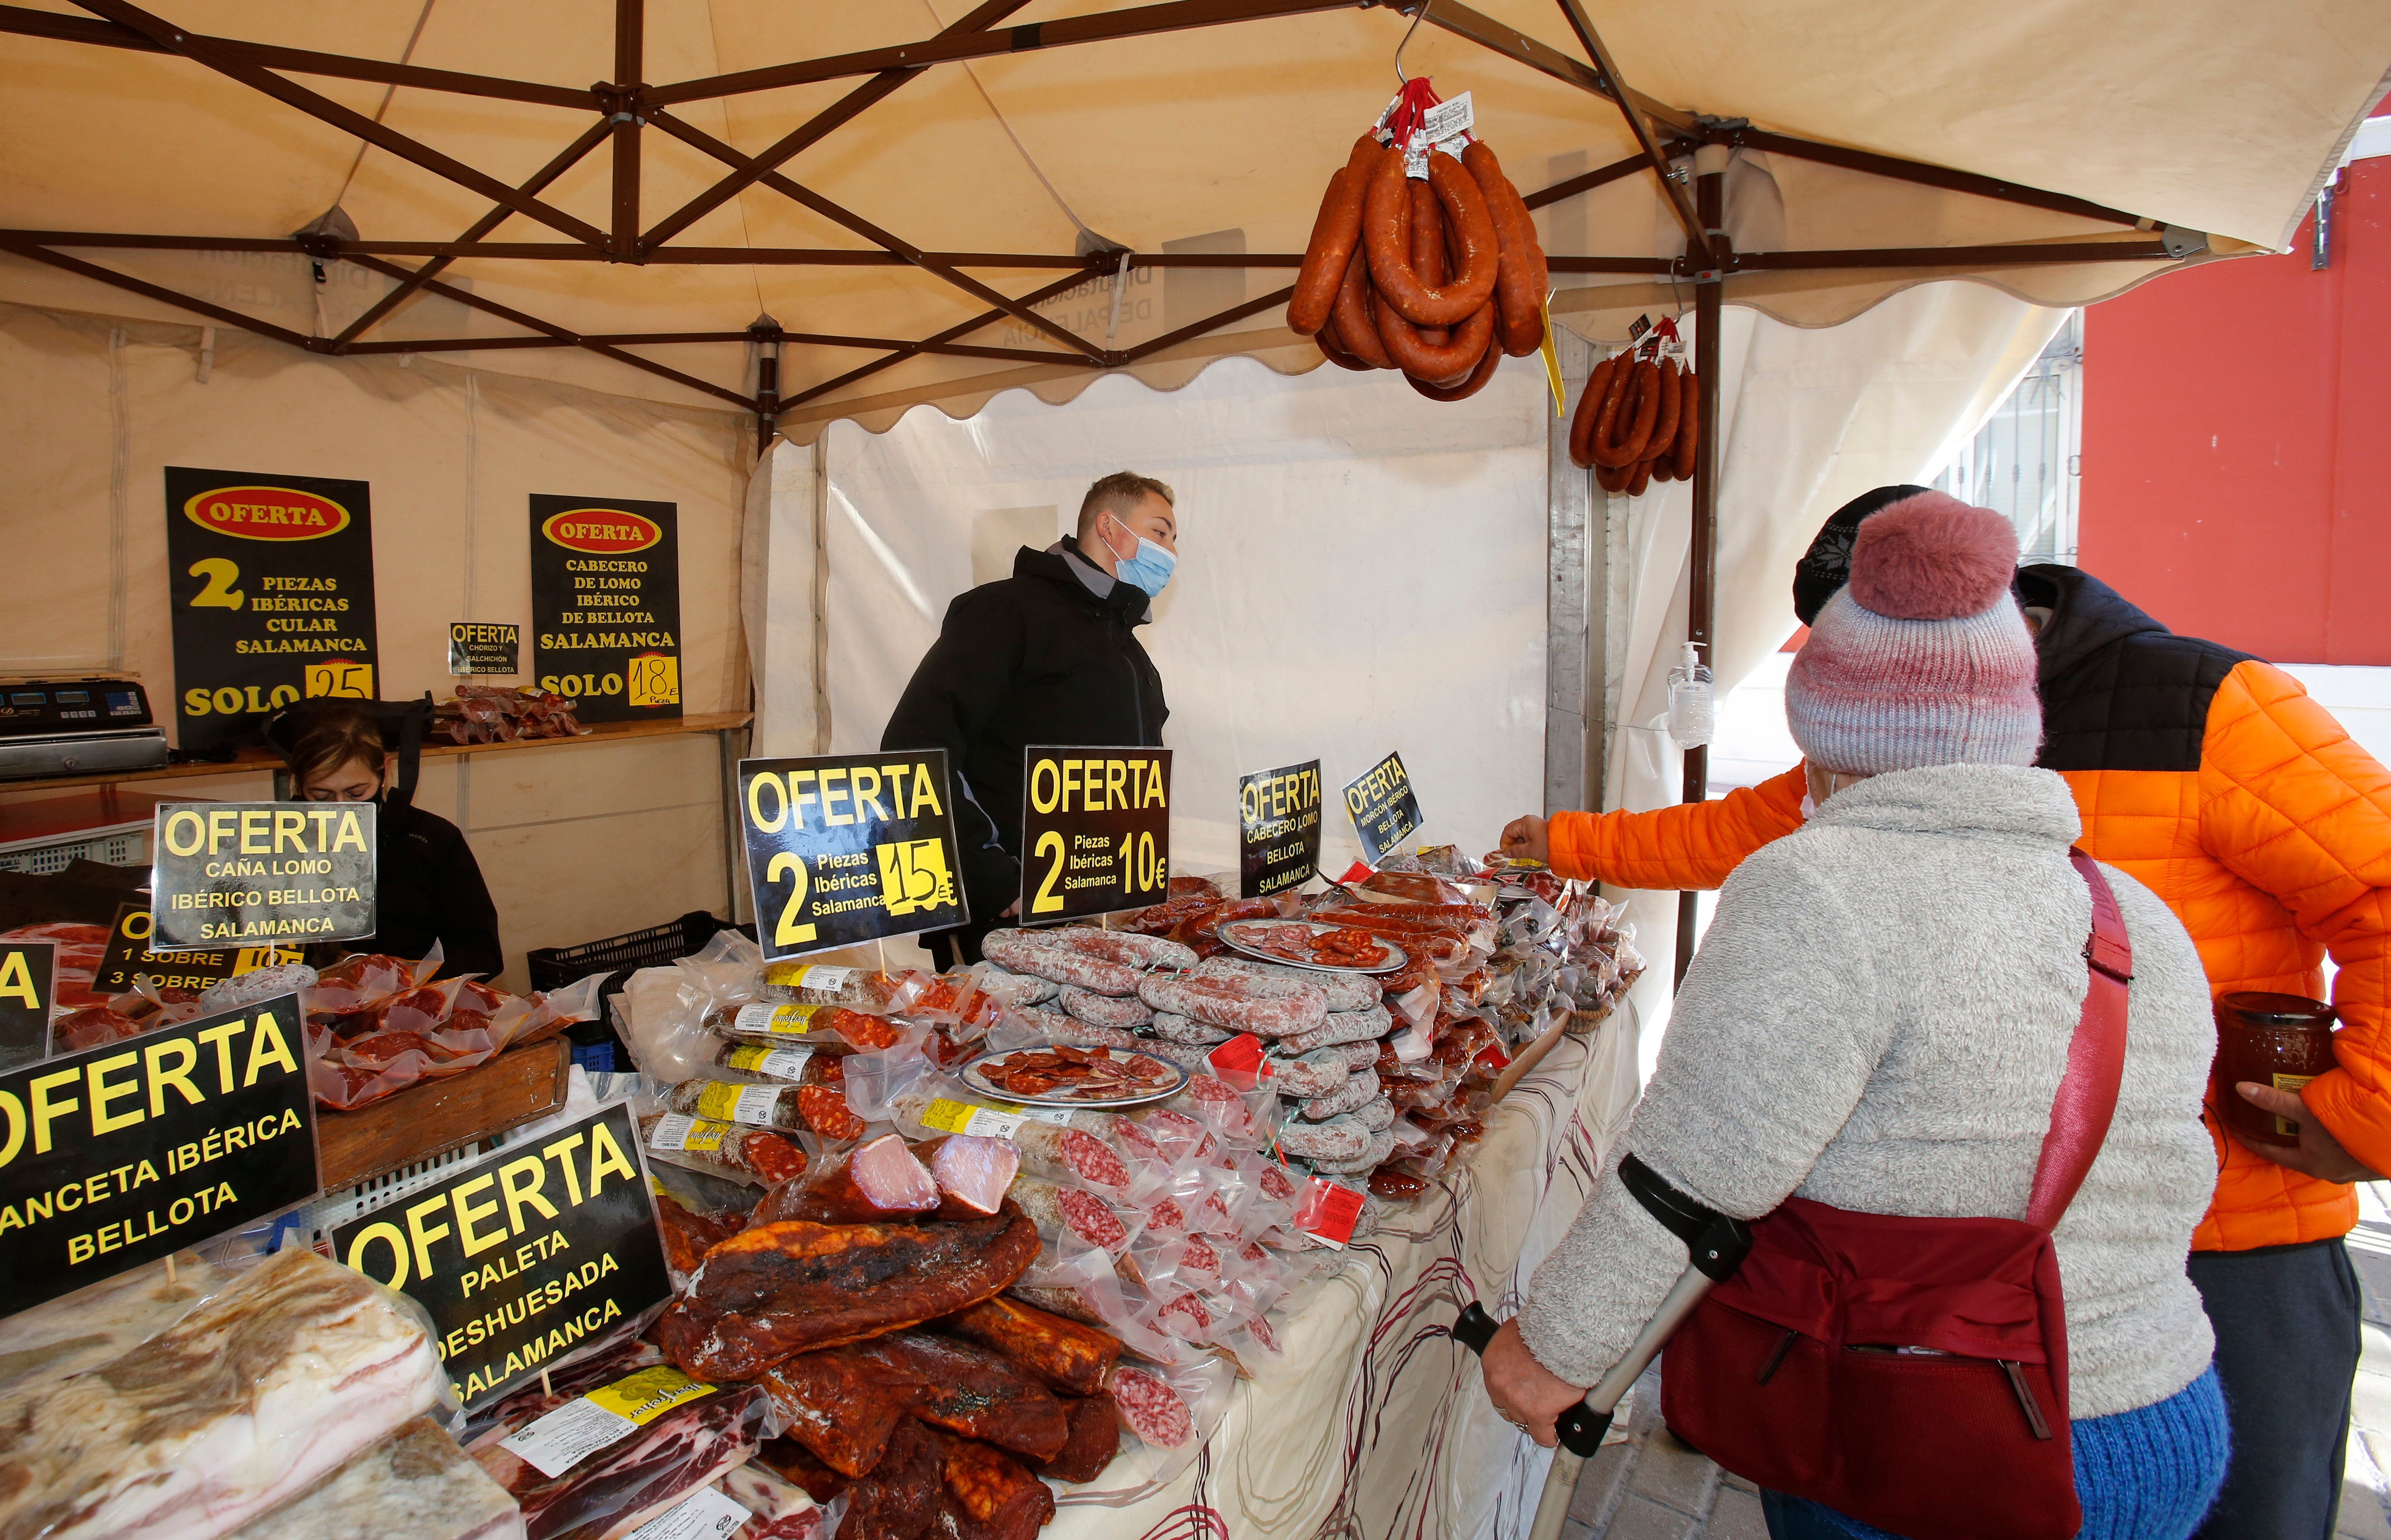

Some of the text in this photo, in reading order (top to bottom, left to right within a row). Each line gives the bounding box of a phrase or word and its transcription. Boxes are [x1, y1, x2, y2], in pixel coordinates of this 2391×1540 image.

[209, 502, 327, 526] OFERTA
[560, 523, 645, 541] OFERTA
[566, 560, 648, 572] CABECERO
[188, 557, 245, 611] 2
[262, 576, 337, 591] PIEZAS
[574, 577, 641, 589] DE LOMO
[251, 594, 349, 612] IBÉRICAS
[577, 592, 640, 606] IBÉRICO
[266, 619, 337, 632] CULAR
[562, 612, 655, 624] DE BELLOTA
[235, 638, 367, 653] SALAMANCA
[452, 624, 518, 643] OFERTA
[540, 632, 675, 649] SALAMANCA
[541, 673, 623, 697] SOLO
[632, 659, 667, 700] 18
[185, 684, 300, 716] SOLO
[1031, 759, 1166, 814] OFERTA
[1242, 768, 1320, 824] OFERTA
[1347, 756, 1407, 815] OFERTA
[748, 763, 943, 834] OFERTA
[1361, 785, 1409, 828] MORCÓN IBÉRICO
[165, 810, 368, 857] OFERTA
[1247, 811, 1318, 844] CABECERO LOMO
[1378, 809, 1404, 834] BELLOTA
[1379, 820, 1414, 854] SALAMANCA
[1070, 854, 1113, 869] Ibéricas
[1267, 841, 1304, 865] BELLOTA
[206, 858, 332, 877] CAÑA LOMO
[814, 871, 877, 893] Ibéricas
[890, 841, 937, 905] 15
[1032, 831, 1110, 914] 2 Piezas
[1259, 863, 1310, 894] SALAMANCA
[1065, 874, 1117, 890] Salamanca
[172, 887, 360, 910] IBÉRICO BELLOTA
[767, 851, 869, 947] 2 Piezas
[812, 894, 886, 916] Salamanca
[200, 917, 335, 939] SALAMANCA
[122, 947, 133, 960] 1
[140, 950, 224, 965] SOBRE
[110, 972, 124, 983] 3
[0, 1108, 302, 1235] ANCETA IBÉRICA
[347, 1121, 637, 1291] OFERTA
[68, 1181, 238, 1266] BELLOTA
[460, 1230, 570, 1298] PALETA
